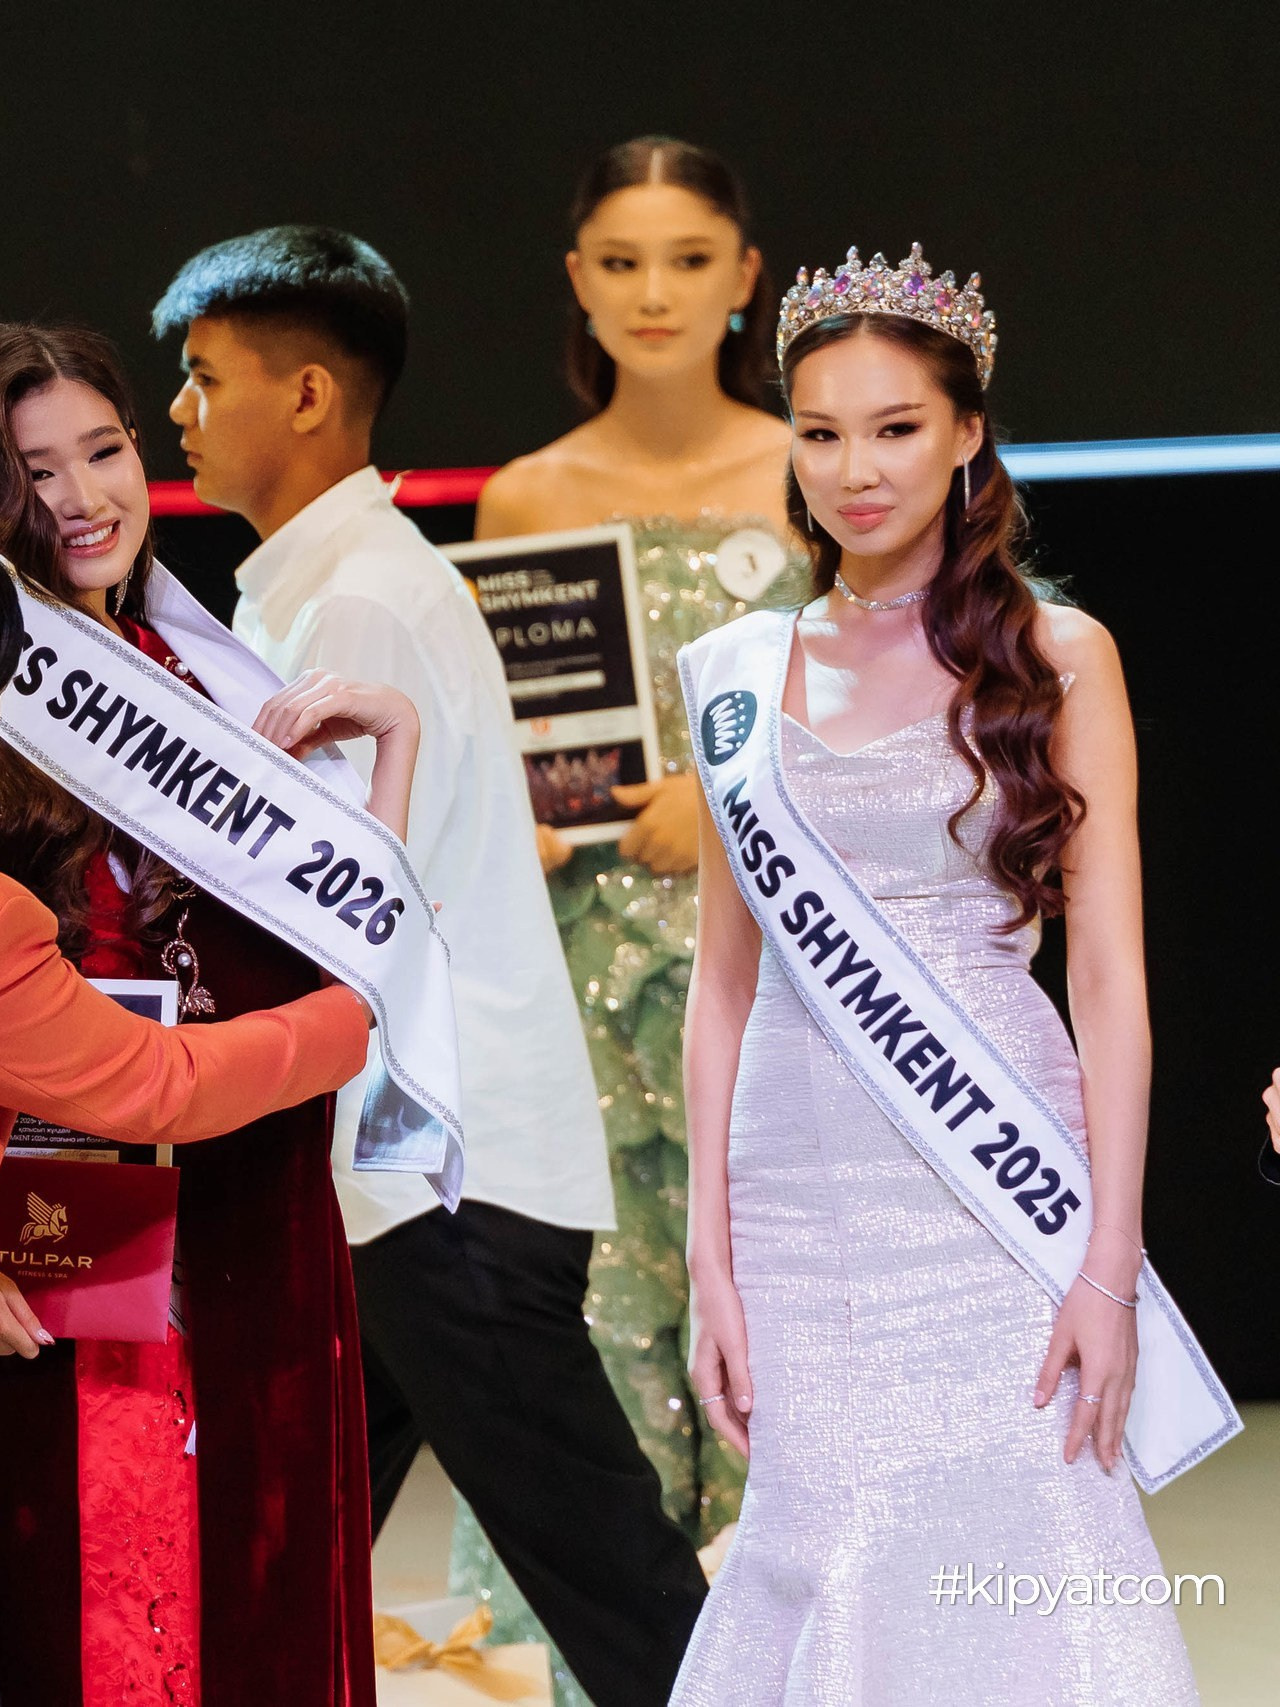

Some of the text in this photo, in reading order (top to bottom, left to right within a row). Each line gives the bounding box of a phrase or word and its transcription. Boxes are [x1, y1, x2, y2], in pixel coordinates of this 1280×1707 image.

[495, 617, 597, 648] PLOMA
[46, 669, 405, 946] SHYMKENT 2026
[723, 776, 1082, 1236] MISS SHYMKENT 2025
